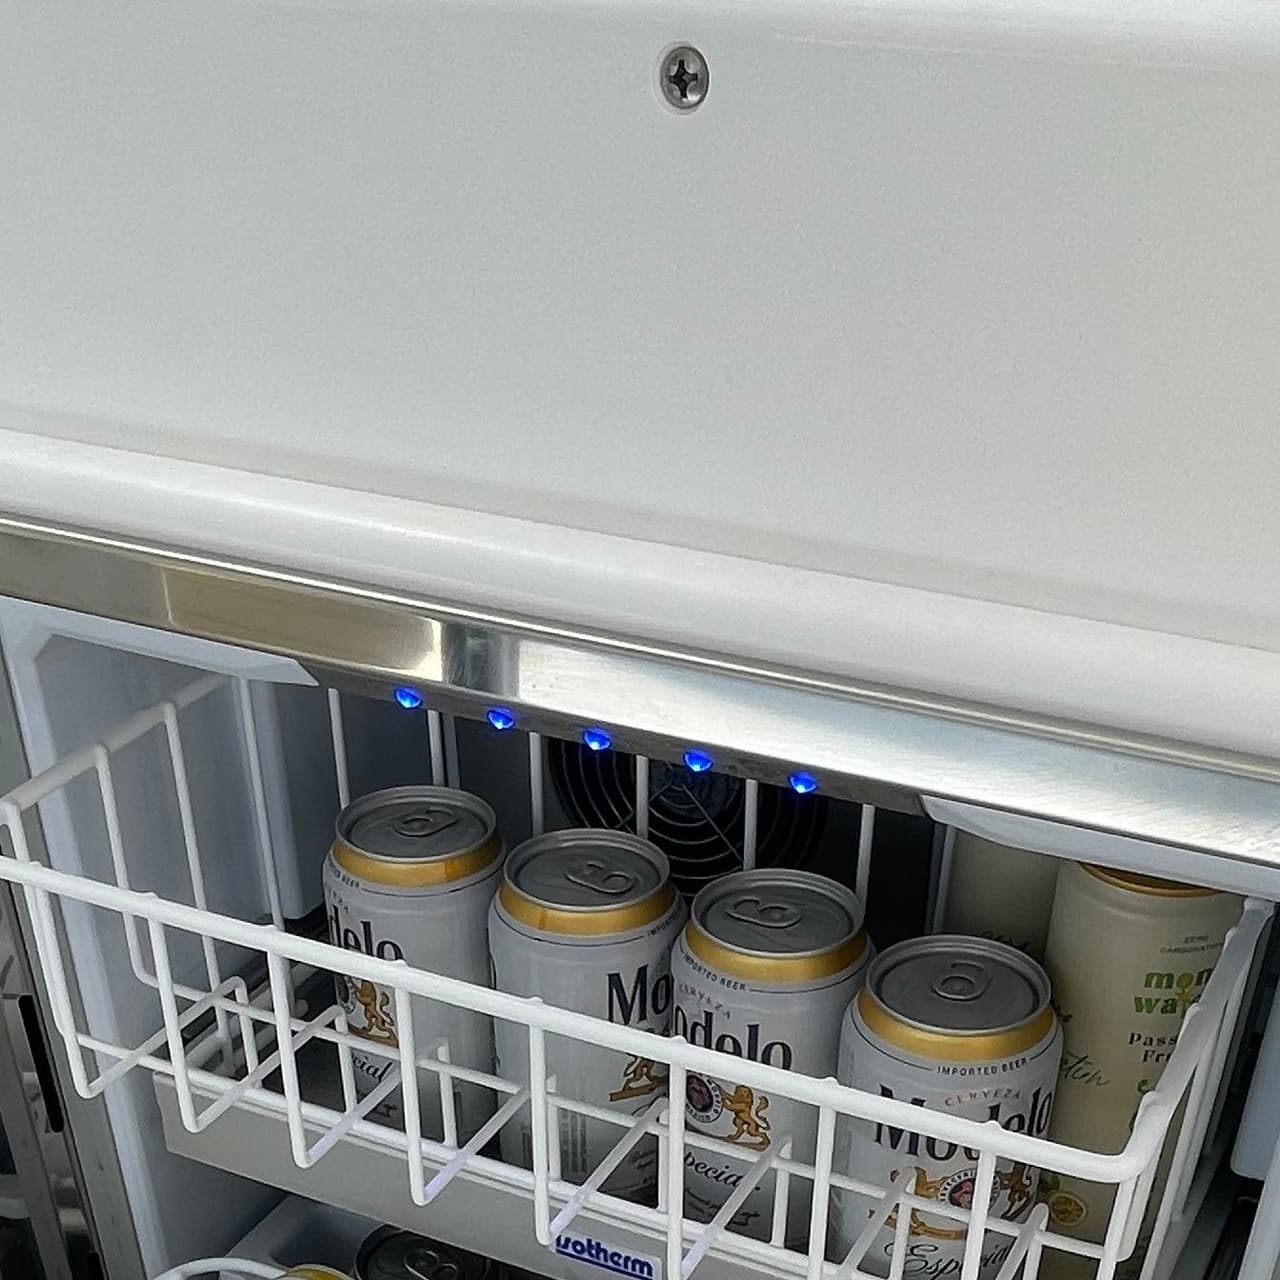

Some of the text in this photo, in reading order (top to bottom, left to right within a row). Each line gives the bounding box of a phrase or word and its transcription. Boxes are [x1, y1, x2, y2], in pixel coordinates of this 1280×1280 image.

[683, 952, 746, 991] IMPORTED BEER
[1128, 1032, 1177, 1046] Pass
[937, 1058, 1028, 1075] IMPORTED BEER
[945, 1088, 1022, 1107] CERVEZA
